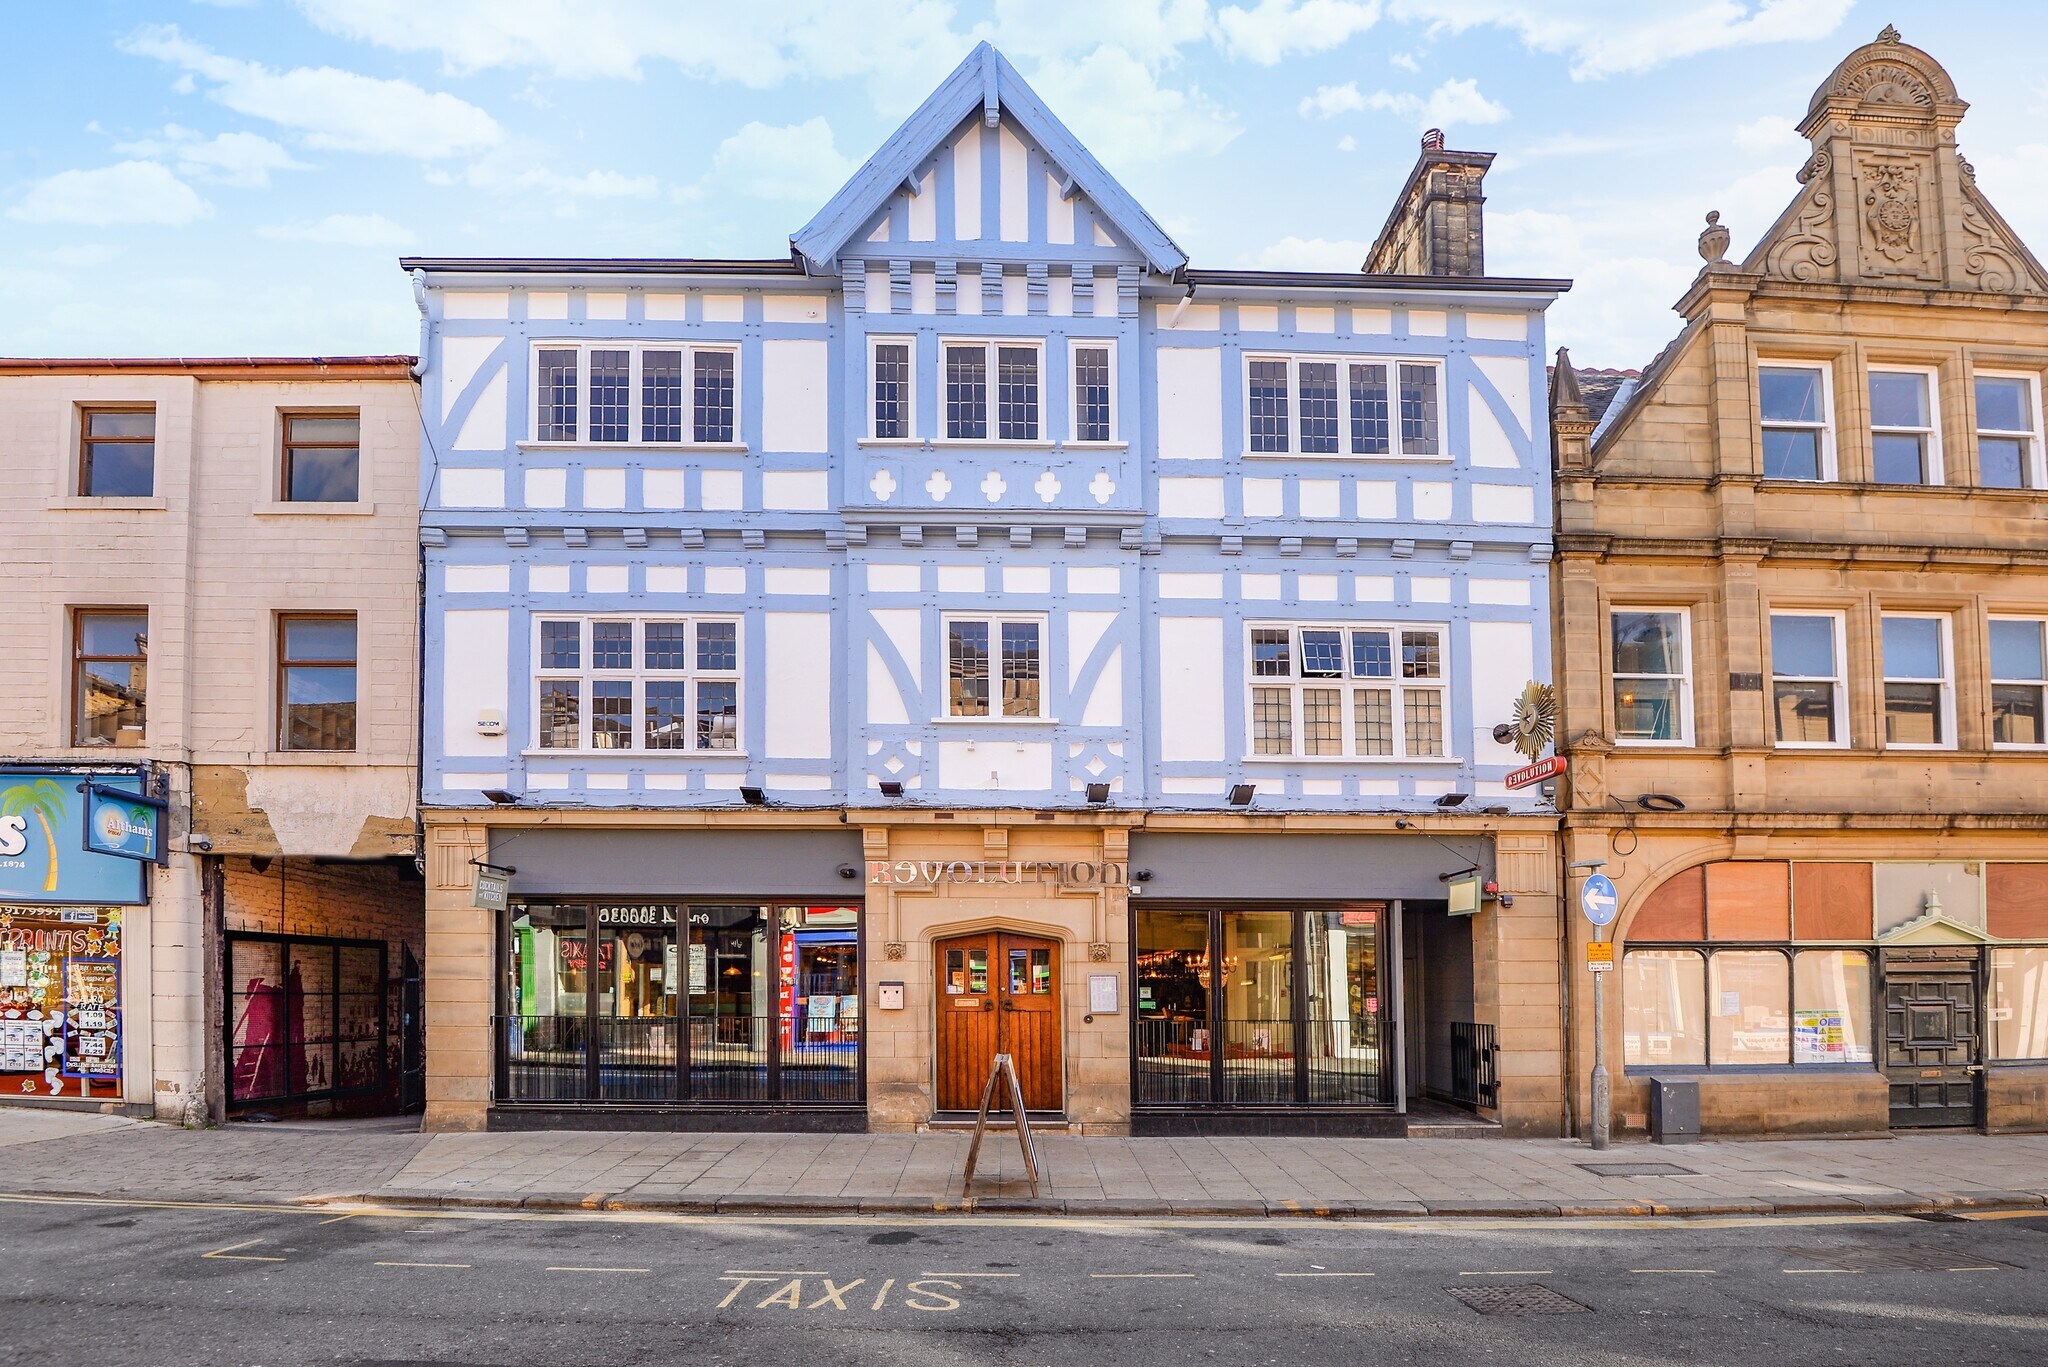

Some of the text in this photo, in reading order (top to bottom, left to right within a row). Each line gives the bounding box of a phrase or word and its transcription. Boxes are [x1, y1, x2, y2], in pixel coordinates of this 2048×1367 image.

[1508, 760, 1553, 786] REVOLUTION
[107, 818, 153, 837] Althams
[479, 880, 503, 893] COCKTAILS
[483, 891, 502, 902] KITCHEN
[80, 1003, 104, 1011] RATE
[715, 1276, 963, 1311] TAXIS
